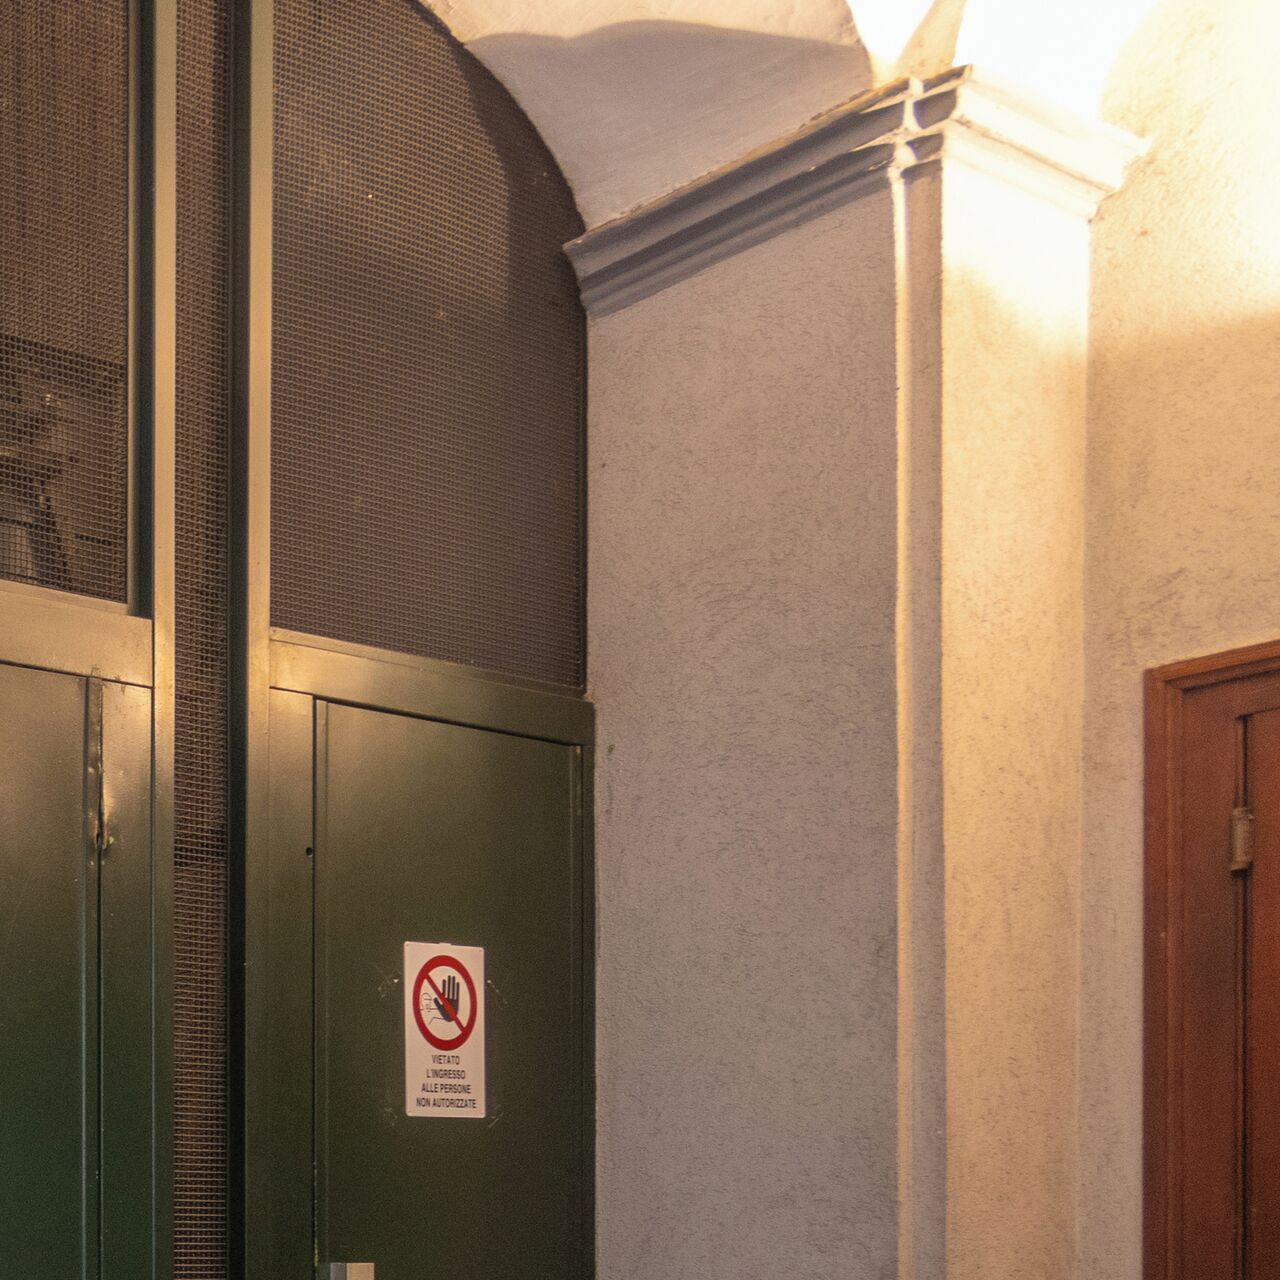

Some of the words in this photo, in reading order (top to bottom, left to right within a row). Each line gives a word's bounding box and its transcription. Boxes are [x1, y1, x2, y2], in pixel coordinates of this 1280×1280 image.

[432, 1054, 460, 1065] VIETATO
[426, 1068, 466, 1080] L'INGRESSO
[421, 1083, 438, 1093] ALLE
[440, 1084, 472, 1094] PERSONE
[416, 1098, 430, 1108] NON
[432, 1098, 476, 1108] AUTORIZZATE
